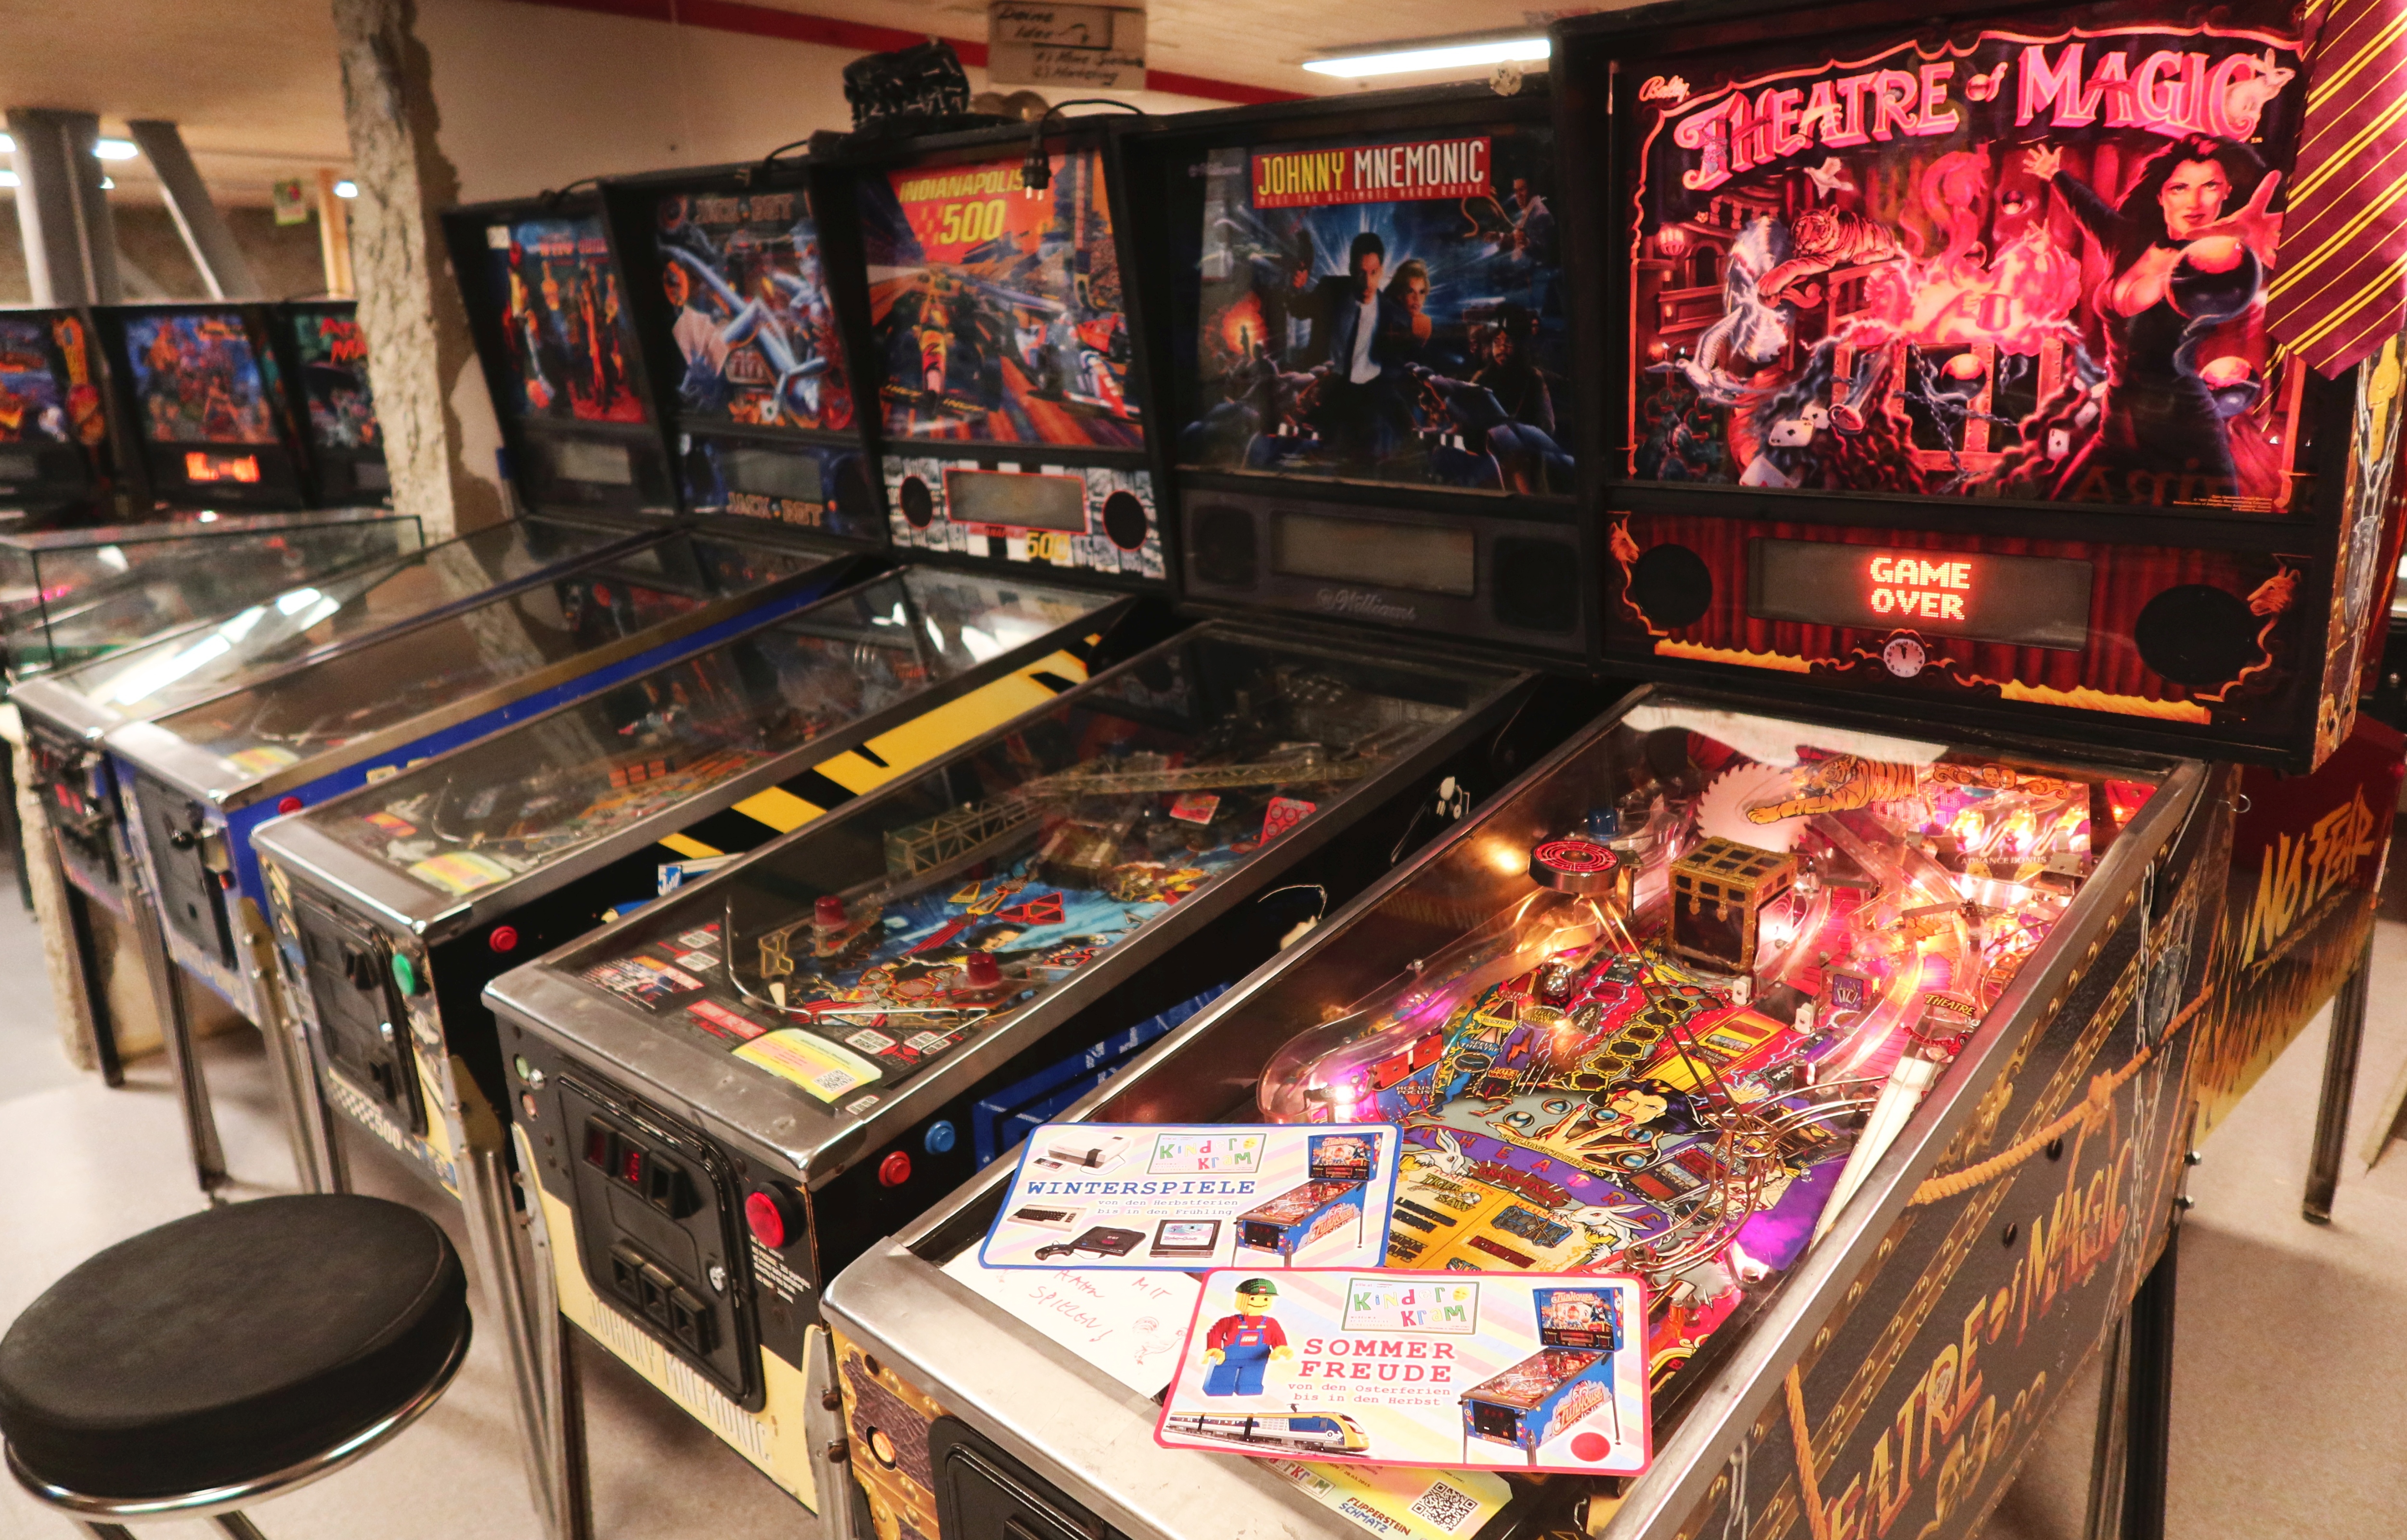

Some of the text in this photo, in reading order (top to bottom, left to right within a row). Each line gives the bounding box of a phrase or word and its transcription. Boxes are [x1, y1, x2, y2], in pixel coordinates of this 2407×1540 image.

[1674, 42, 2263, 191] THEATRE of MAGIC
[1258, 140, 1485, 196] JOHNNY MNEMONIC
[899, 168, 1023, 203] INDIANAPOLIS
[939, 200, 1007, 244] 500
[1026, 532, 1071, 560] 500
[1869, 555, 1972, 591] GAME
[1870, 590, 1966, 621] OVER
[1962, 856, 2047, 865] ADVANCE BONUS
[2302, 783, 2375, 916] FEAR
[1925, 994, 1976, 1016] THEATRE
[1027, 1181, 1256, 1195] WINTERSPIELE
[1420, 1172, 1463, 1192] TIGER
[1175, 1208, 1233, 1217] Frühling
[1436, 1194, 1477, 1212] SAW
[2016, 1137, 2132, 1348] MAGIC
[1303, 1338, 1455, 1360] SOMMER
[1298, 1360, 1451, 1383] FREUDE
[1294, 1393, 1441, 1406] bis in den Herbst
[1321, 1383, 1346, 1391] den
[1355, 1385, 1450, 1395] Osterferien
[1338, 1502, 1388, 1533] SCHMATZ
[1346, 1497, 1411, 1536] FLIPPERSTEIN
